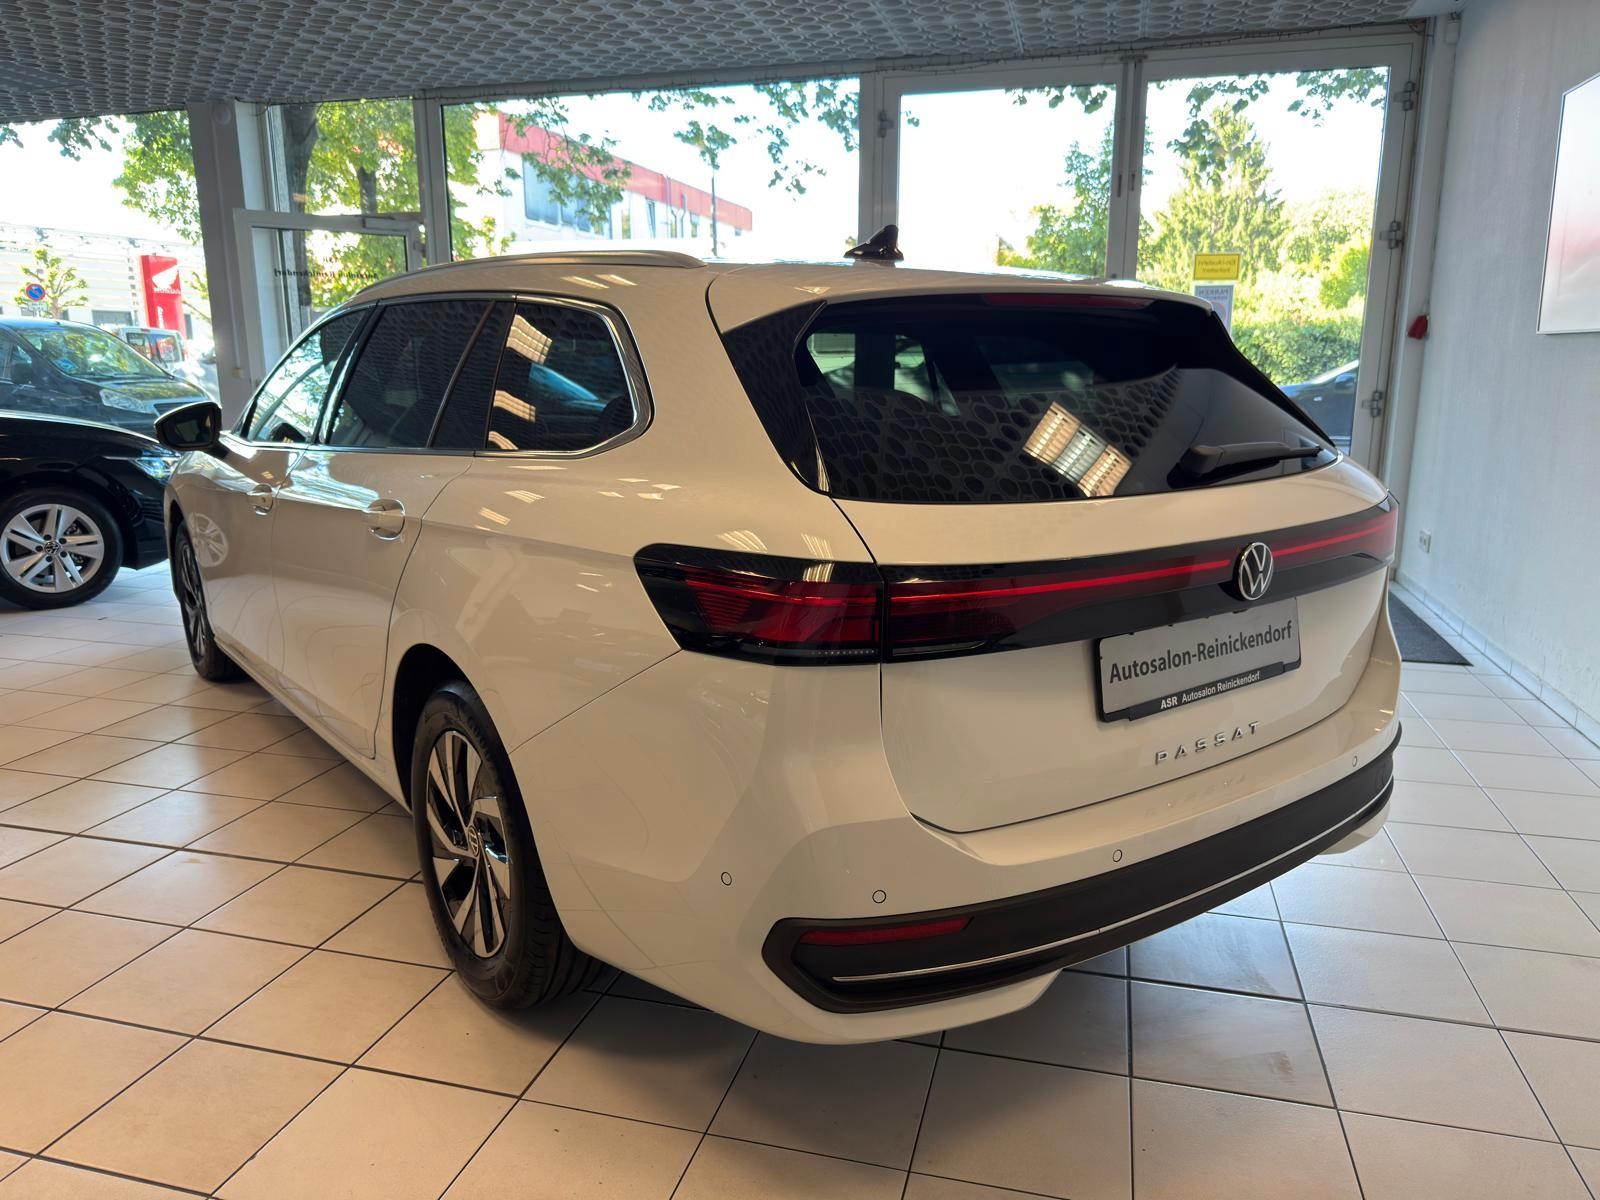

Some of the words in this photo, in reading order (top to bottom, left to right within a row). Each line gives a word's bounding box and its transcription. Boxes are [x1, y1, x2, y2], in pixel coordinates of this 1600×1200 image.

[1109, 620, 1293, 684] Autosalon-Reinickendorf
[1160, 696, 1178, 710] ASR
[1182, 686, 1216, 703] Autosalon
[1217, 671, 1260, 692] Reinickendorf
[1155, 721, 1261, 765] PASSAT
